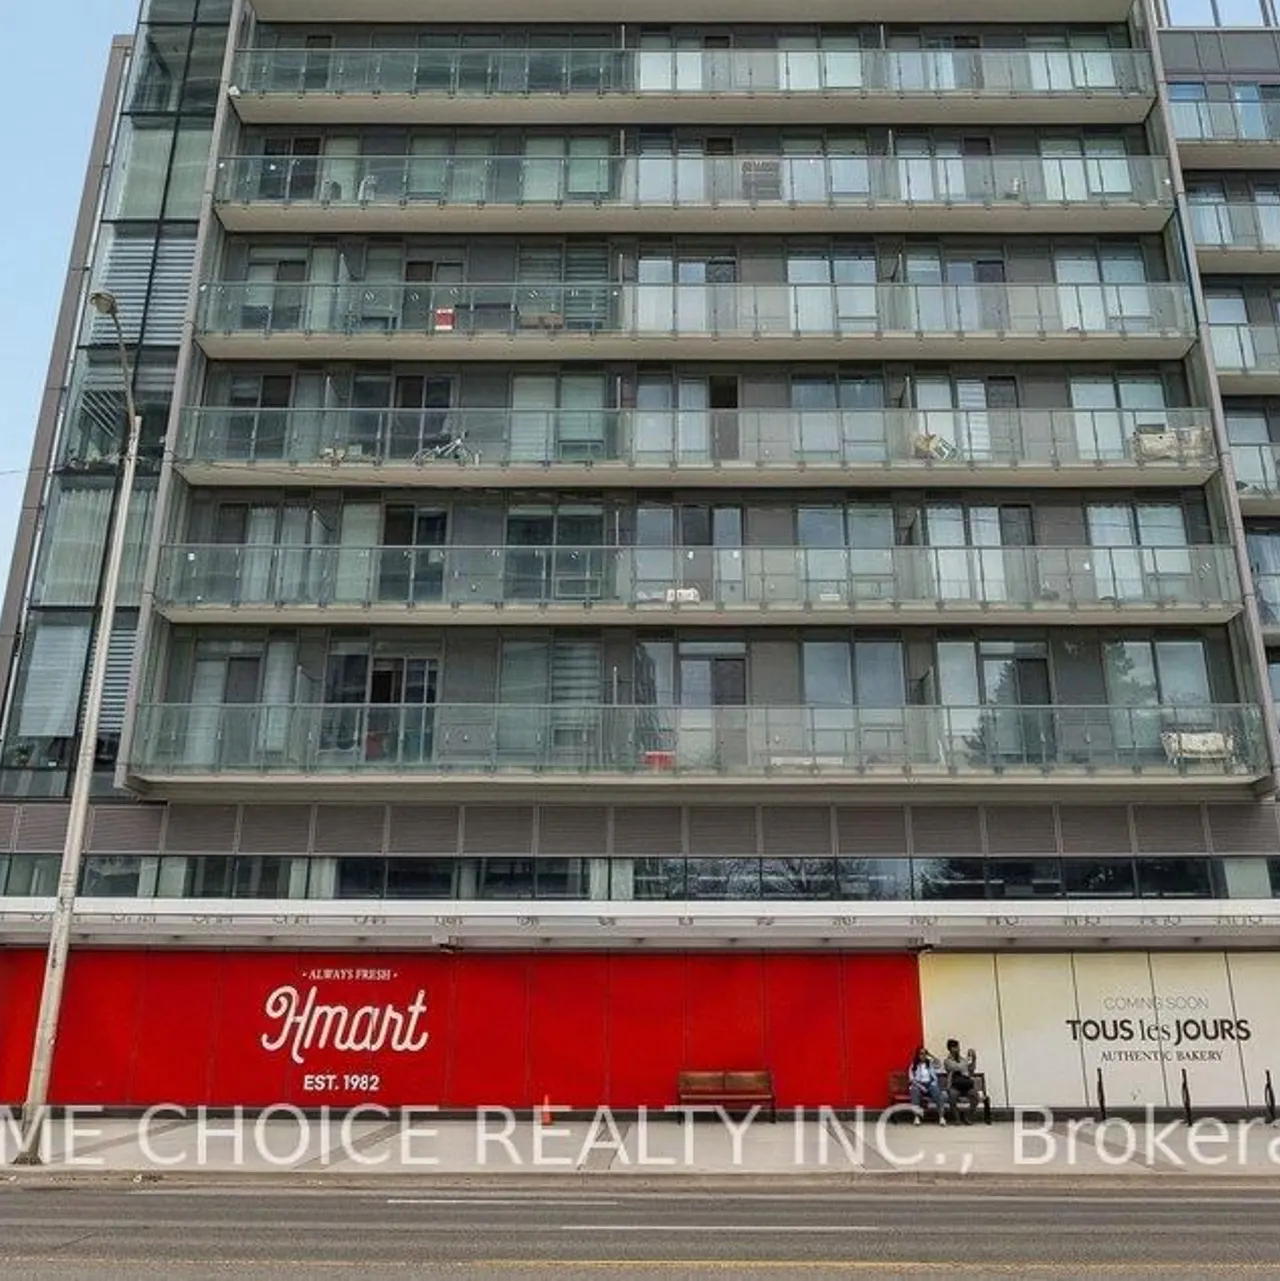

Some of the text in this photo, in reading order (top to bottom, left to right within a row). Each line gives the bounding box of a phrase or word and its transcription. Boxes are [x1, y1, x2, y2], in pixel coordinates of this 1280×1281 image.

[308, 969, 391, 980] ALWAYS FRESH
[1167, 996, 1210, 1010] SOON
[261, 985, 429, 1064] Hmart
[1066, 1019, 1252, 1046] TOUS les JOURS
[1176, 1050, 1222, 1061] BAKERY
[303, 1075, 380, 1090] EST. 1982
